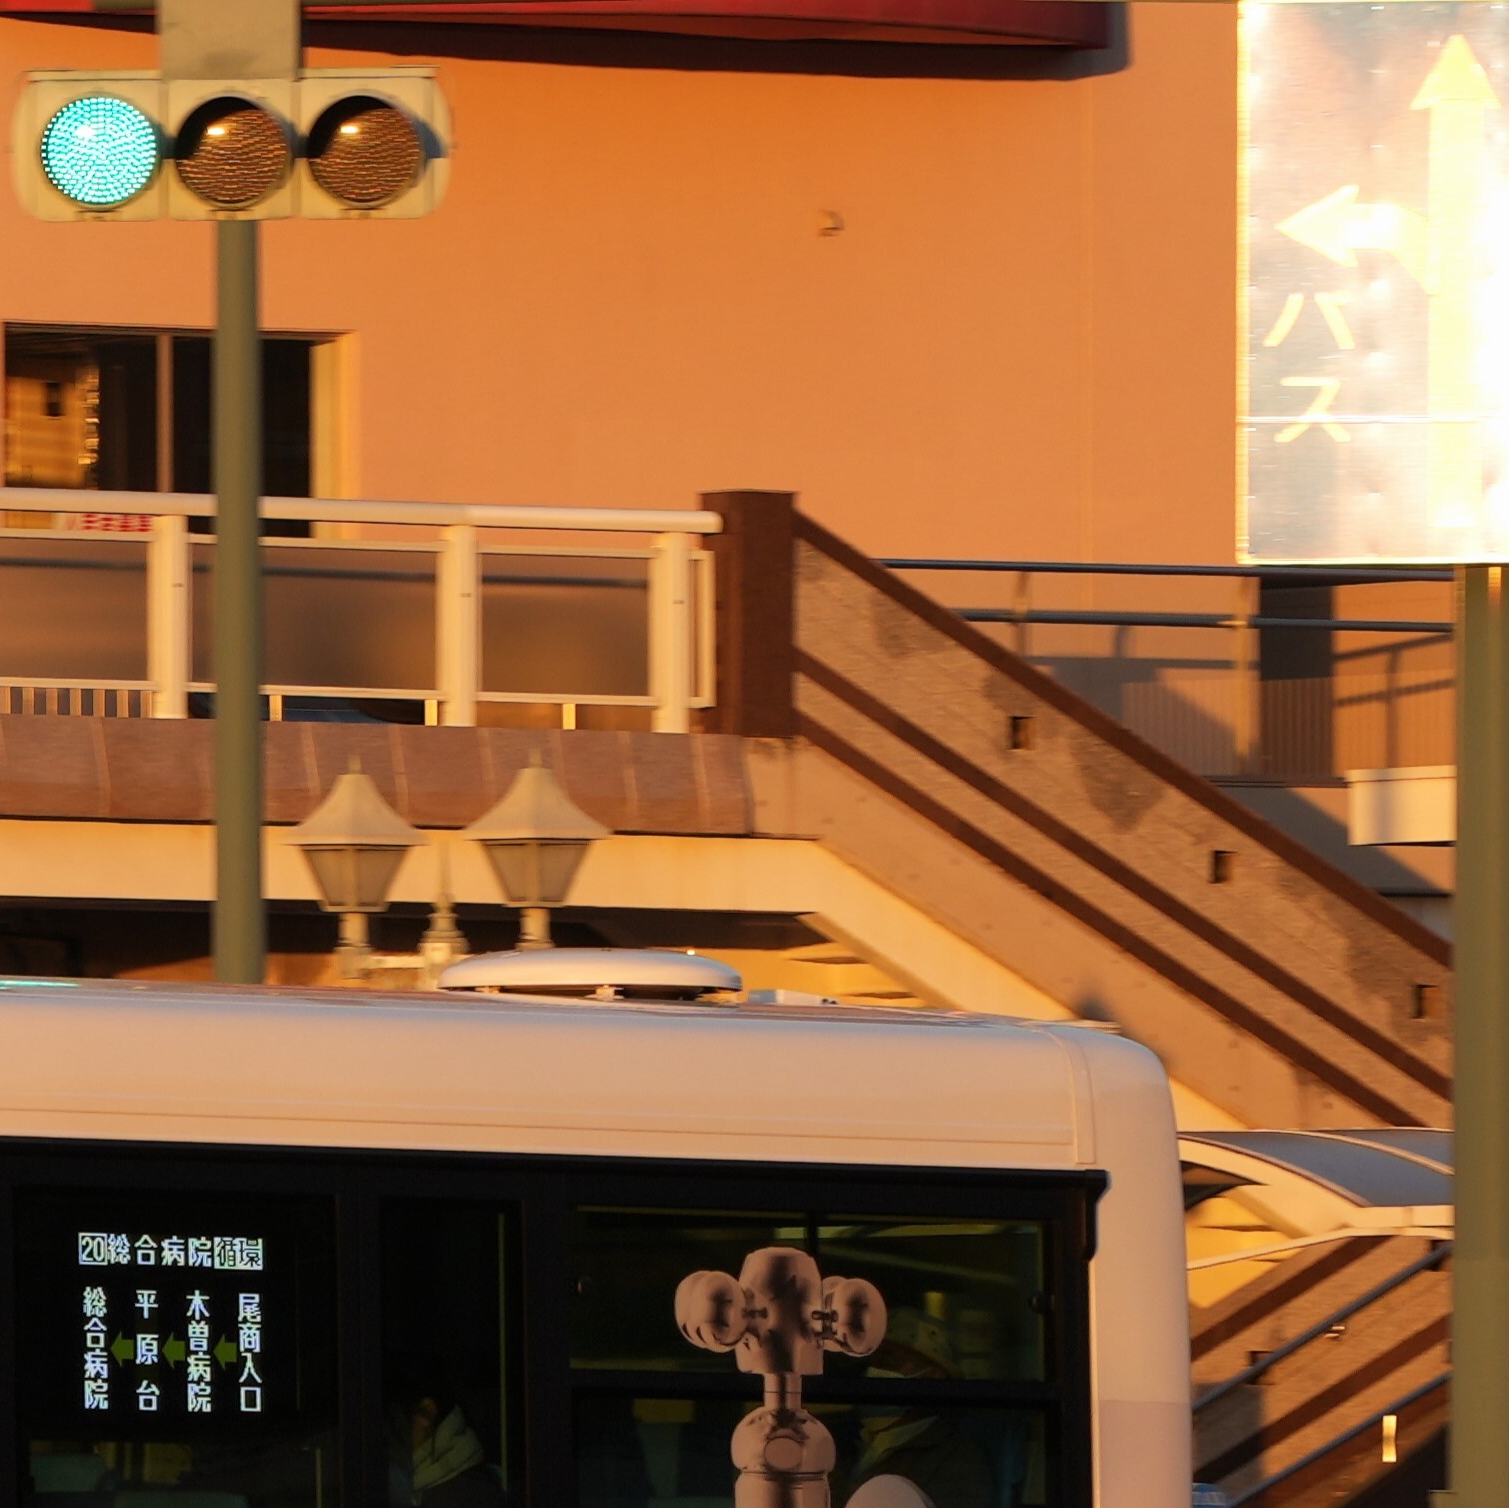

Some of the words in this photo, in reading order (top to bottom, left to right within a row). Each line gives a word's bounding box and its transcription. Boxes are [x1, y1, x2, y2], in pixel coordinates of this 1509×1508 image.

[1263, 292, 1355, 443] バス
[81, 1238, 104, 1262] 20
[107, 1234, 212, 1267] 総合病院
[214, 1238, 262, 1269] 循環
[83, 1287, 108, 1409] 総合病院
[135, 1289, 160, 1411] 平原台
[238, 1293, 262, 1412] 尾商入口
